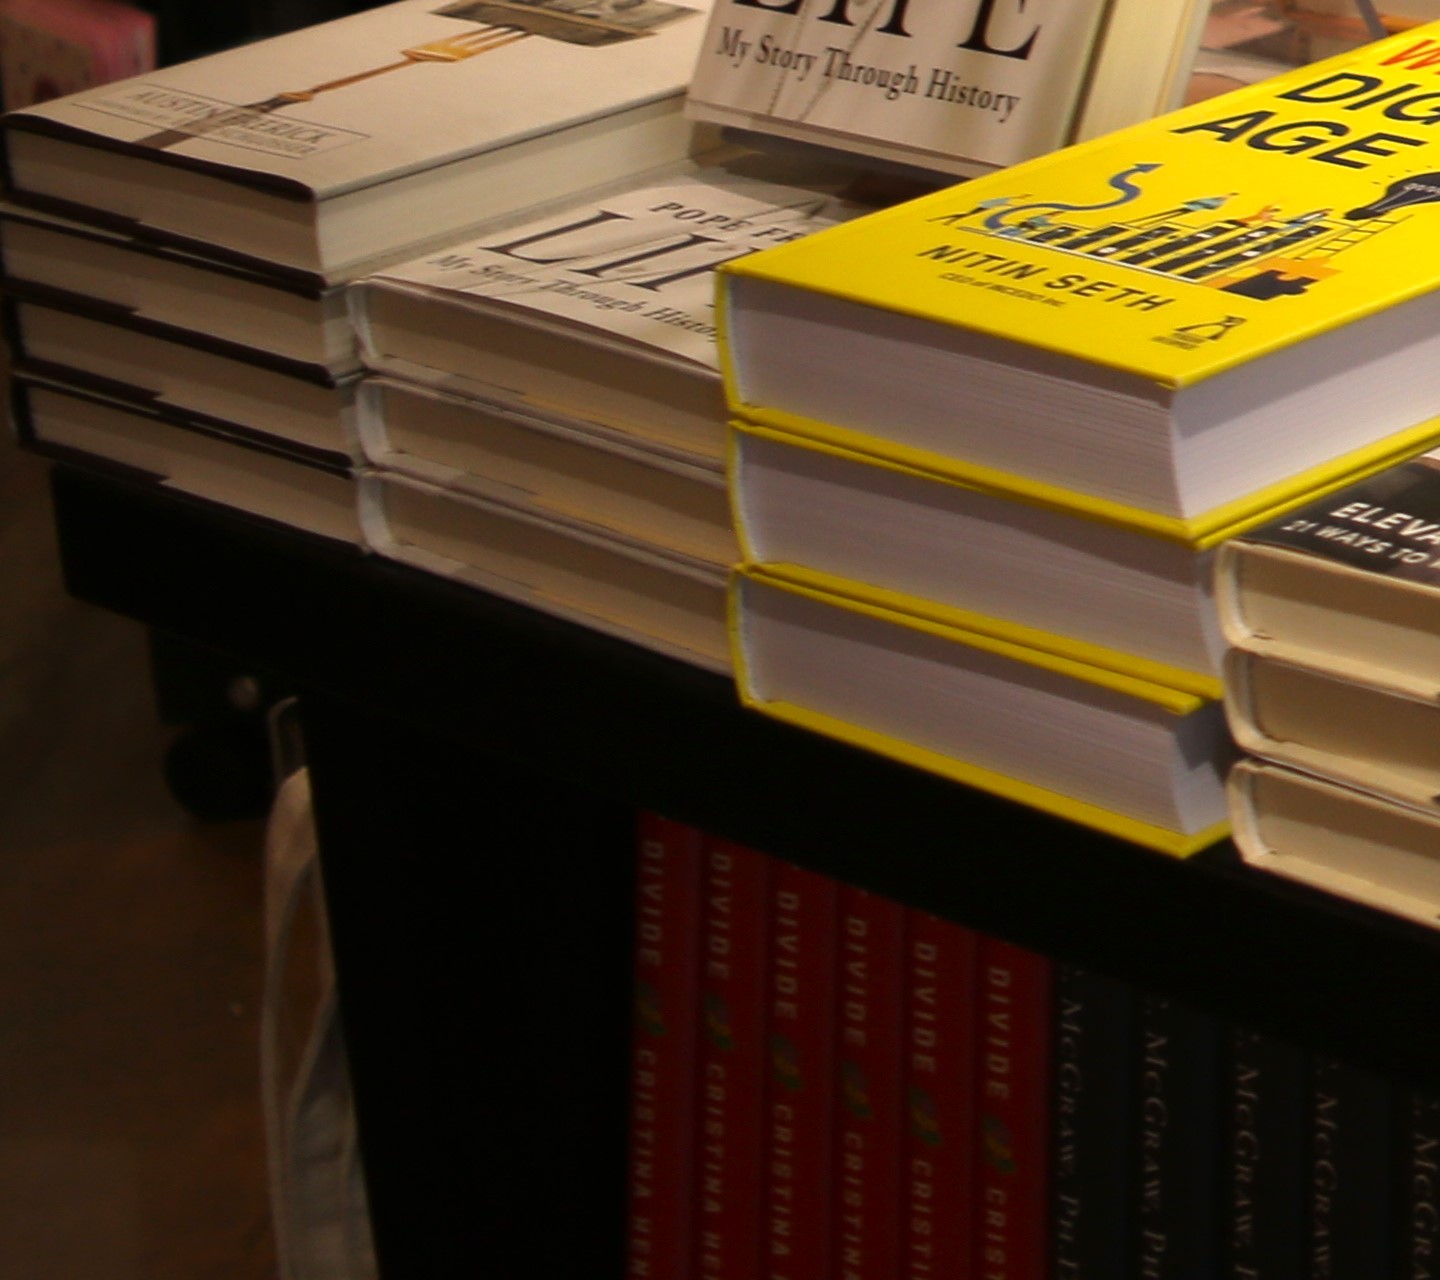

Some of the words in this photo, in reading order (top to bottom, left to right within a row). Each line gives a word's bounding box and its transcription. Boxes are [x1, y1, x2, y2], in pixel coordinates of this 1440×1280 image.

[716, 27, 753, 68] My
[755, 35, 817, 82] Story
[822, 46, 919, 102] Through
[925, 69, 1020, 123] History
[1173, 108, 1428, 171] AGE
[647, 201, 753, 232] POPE
[916, 244, 1048, 281] NITIN
[1044, 274, 1176, 312] SETH
[470, 264, 538, 285] Story
[538, 279, 646, 313] Through
[1280, 519, 1319, 533] 21
[1315, 525, 1393, 555] WAYS
[1388, 548, 1431, 564] TO
[640, 841, 664, 966] DIVIDE
[706, 851, 732, 980] DIVIDE
[774, 889, 799, 1020] DIVIDE
[845, 916, 868, 1046] DIVIDE
[913, 942, 938, 1073] DIVIDE
[986, 966, 1012, 1100] DIVIDE
[633, 1048, 657, 1199] CRISTINA
[703, 1061, 727, 1215] CRISTINA
